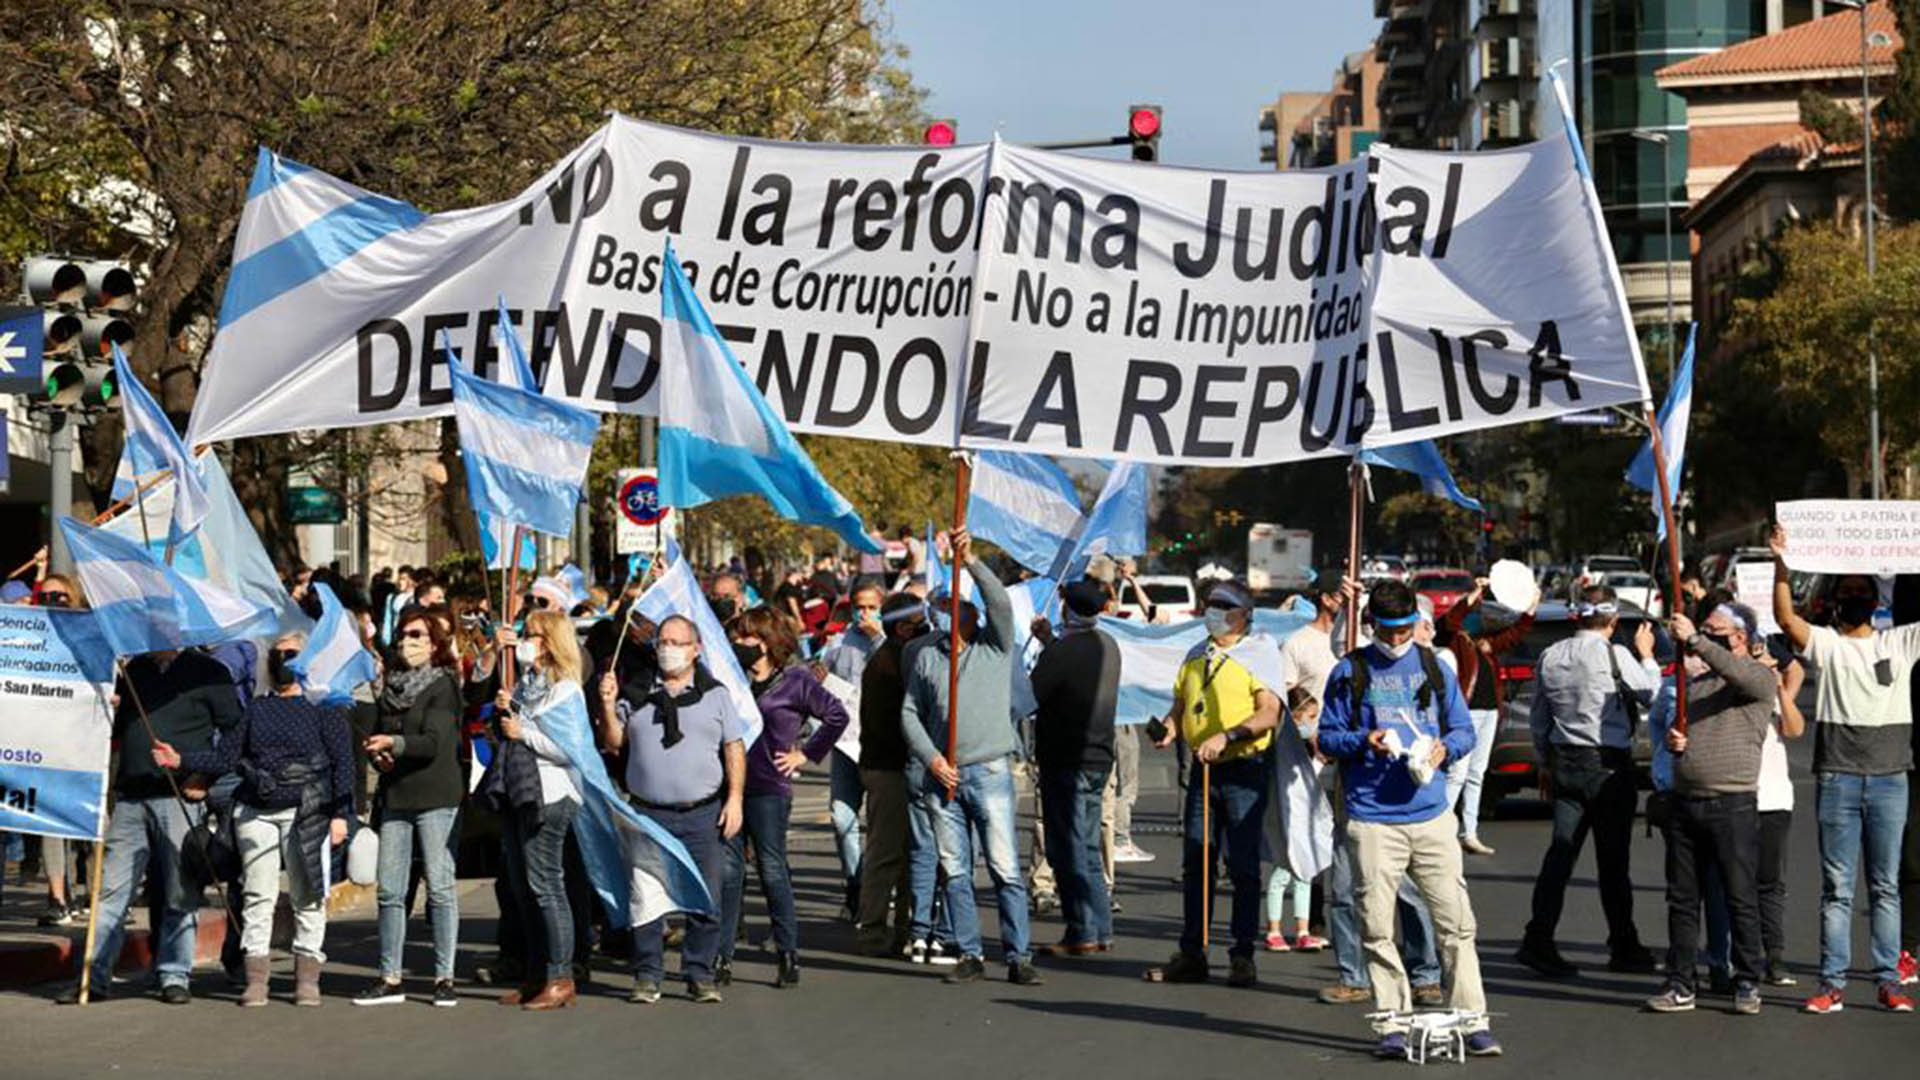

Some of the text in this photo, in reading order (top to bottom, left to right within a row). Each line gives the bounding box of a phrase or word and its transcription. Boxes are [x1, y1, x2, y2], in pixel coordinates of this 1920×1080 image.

[640, 160, 692, 234] a
[716, 146, 793, 246] la
[816, 153, 1141, 271] reforma
[587, 234, 699, 294] Basa
[710, 252, 760, 306] de
[772, 258, 973, 328] Corrupción
[1011, 269, 1074, 328] No
[1085, 292, 1111, 333] a
[1124, 280, 1161, 339] la
[357, 300, 1581, 459] DEFENDNDO LA REPUBLICA
[1841, 510, 1858, 522] LA
[4, 680, 29, 696] San
[0, 748, 43, 764] osto
